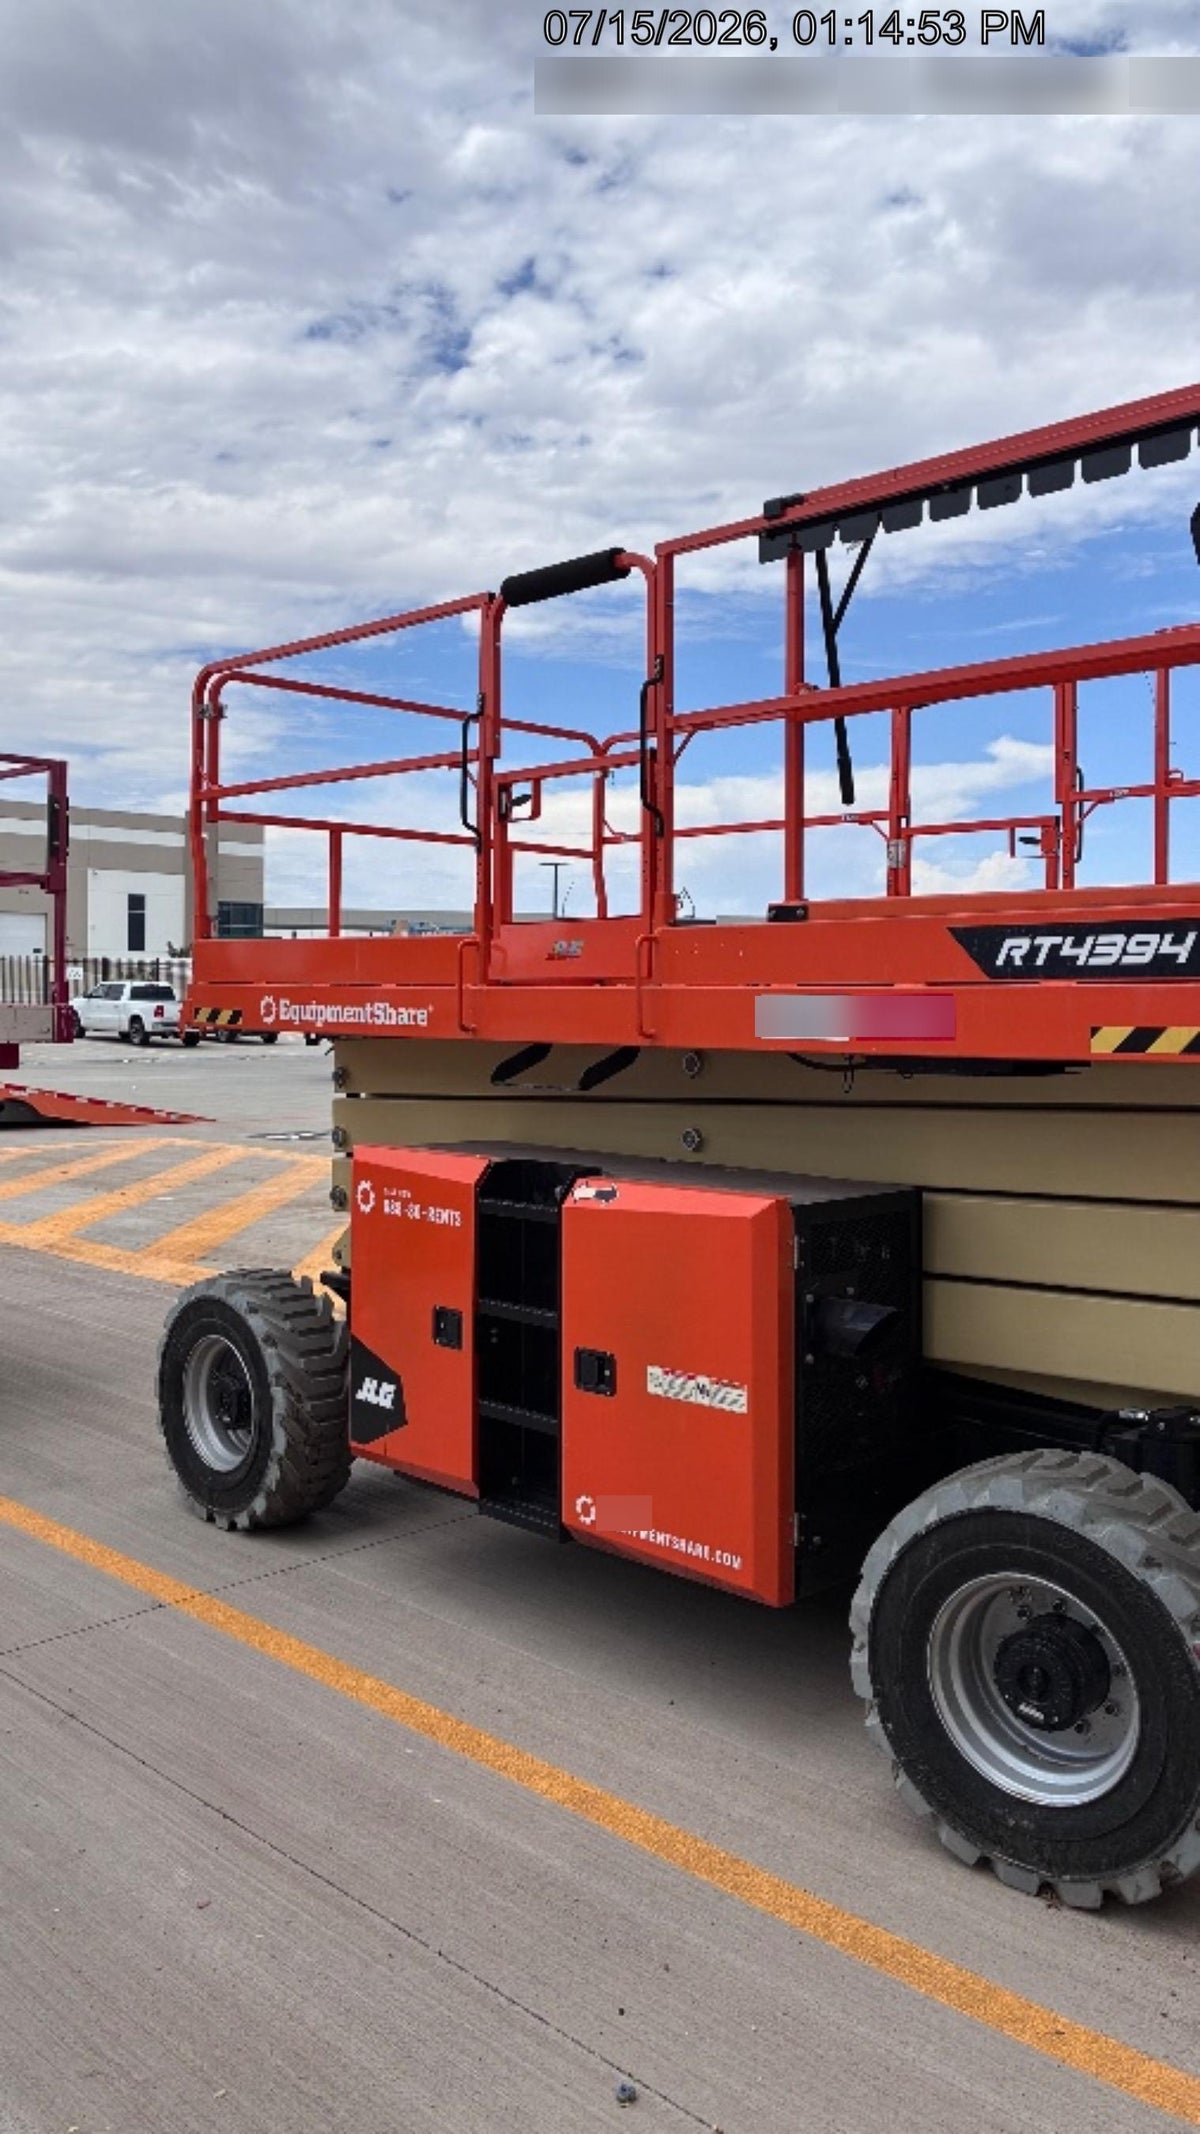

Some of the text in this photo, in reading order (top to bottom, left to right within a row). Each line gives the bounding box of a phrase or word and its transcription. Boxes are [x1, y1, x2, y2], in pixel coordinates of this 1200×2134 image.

[995, 931, 1198, 967] RT4394
[279, 998, 429, 1027] EquipmentShare
[355, 1377, 396, 1409] JLG
